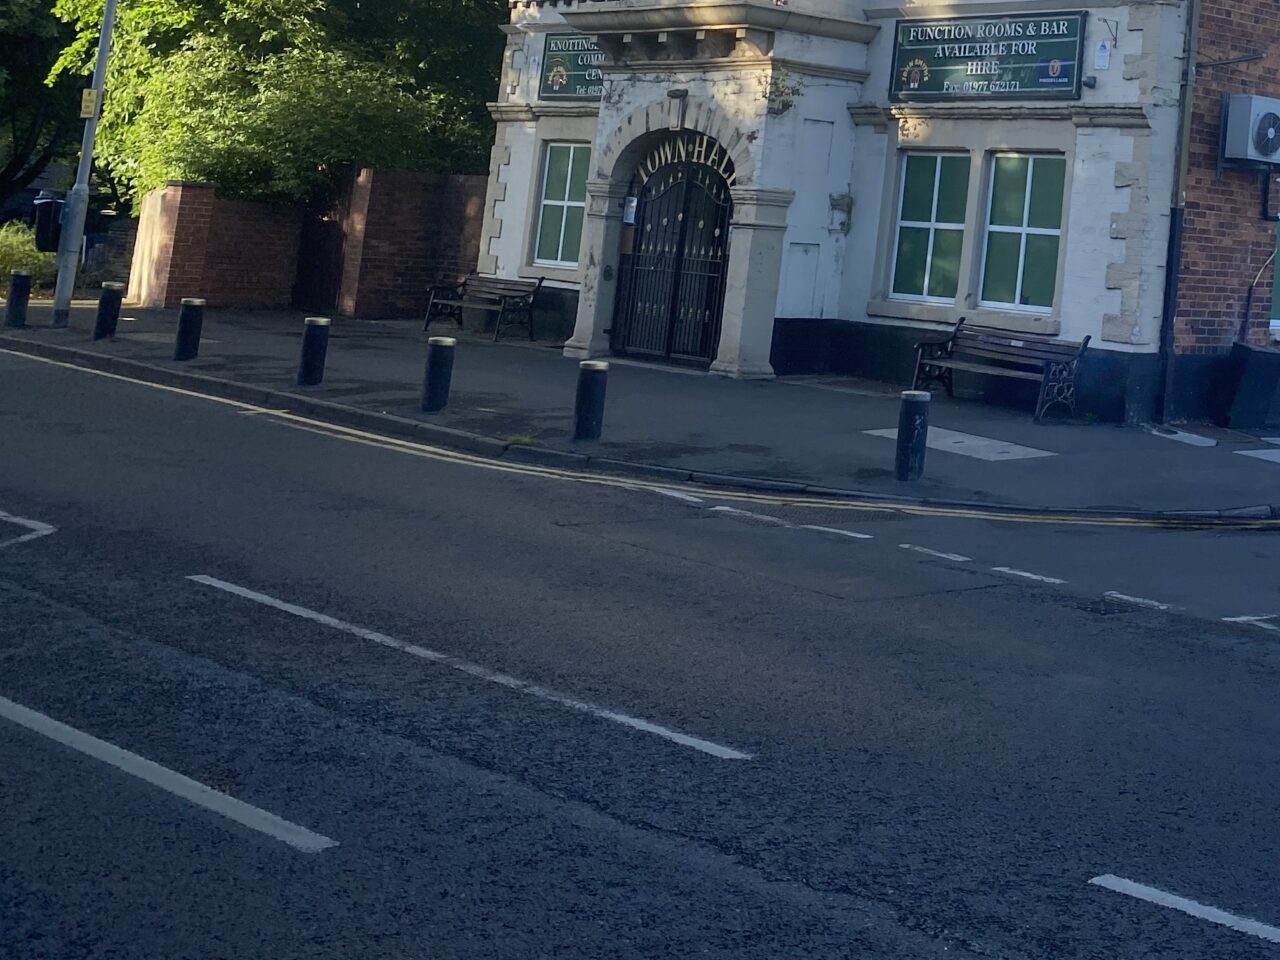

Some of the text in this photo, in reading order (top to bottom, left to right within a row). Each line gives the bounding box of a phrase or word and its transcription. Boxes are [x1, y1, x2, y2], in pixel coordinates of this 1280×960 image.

[909, 21, 1068, 41] FUNCTION ROOMS & BAR
[934, 41, 1037, 58] AVAILABLE FOR
[966, 61, 1000, 75] HIRE
[943, 81, 1020, 92] Fax: 01977 672171
[635, 135, 687, 185] TOWN
